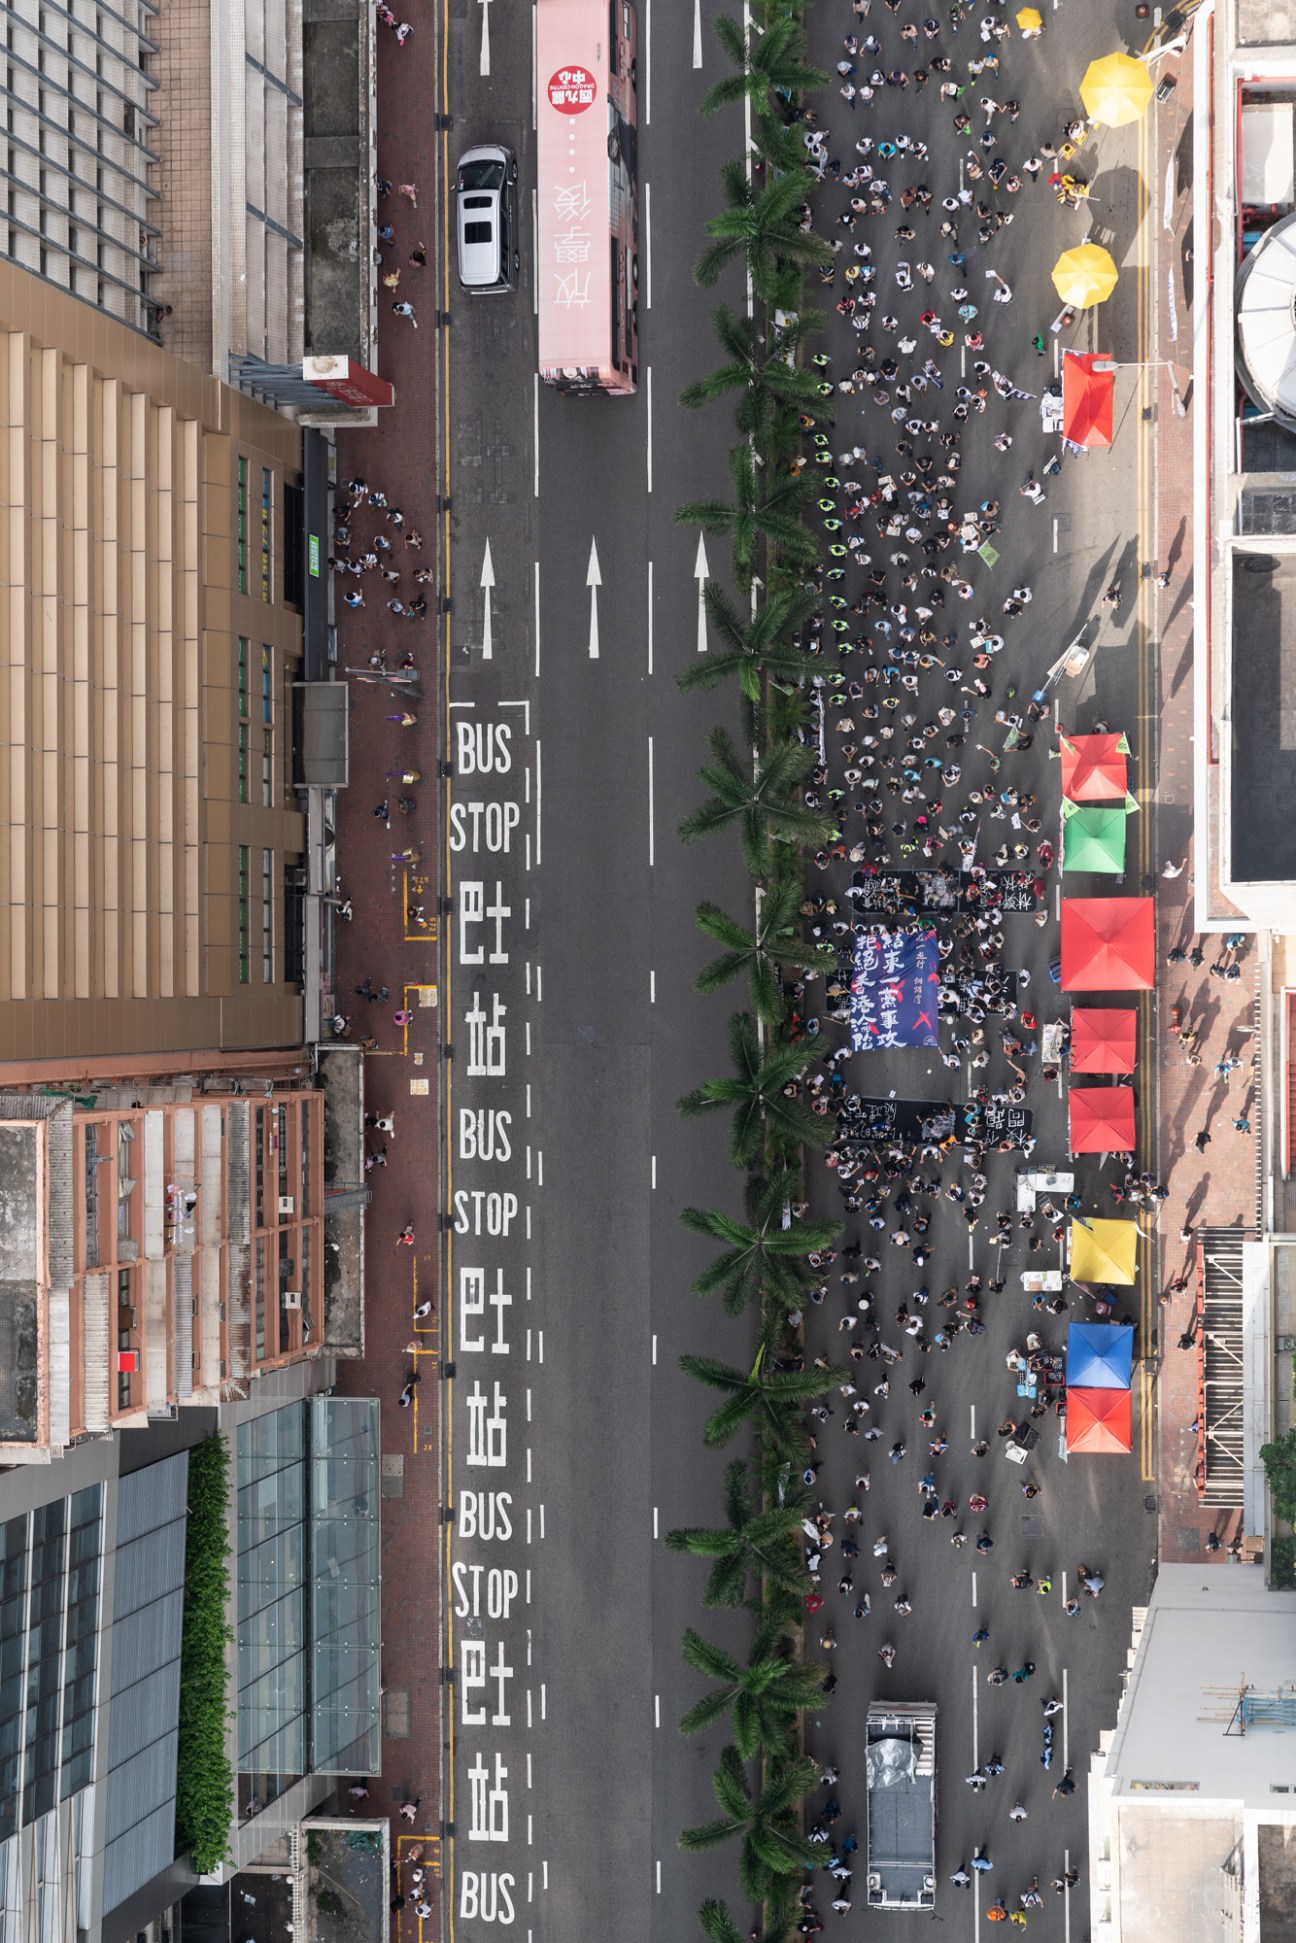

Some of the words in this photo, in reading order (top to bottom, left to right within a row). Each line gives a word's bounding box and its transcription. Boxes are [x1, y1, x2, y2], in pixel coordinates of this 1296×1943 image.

[551, 89, 593, 105] 西九龍
[558, 70, 586, 84] 中心
[457, 722, 511, 774] BUS
[450, 802, 519, 852] STOP
[460, 881, 511, 964] 巴士
[465, 992, 507, 1076] 站
[460, 1109, 511, 1161] BUS
[454, 1190, 517, 1236] STOP
[460, 1267, 512, 1354] 巴士
[466, 1381, 506, 1466] 站
[459, 1491, 512, 1540] BUS
[452, 1562, 518, 1621] STOP
[461, 1640, 513, 1726] 巴士
[468, 1752, 508, 1841] 站
[460, 1871, 515, 1924] BUS
